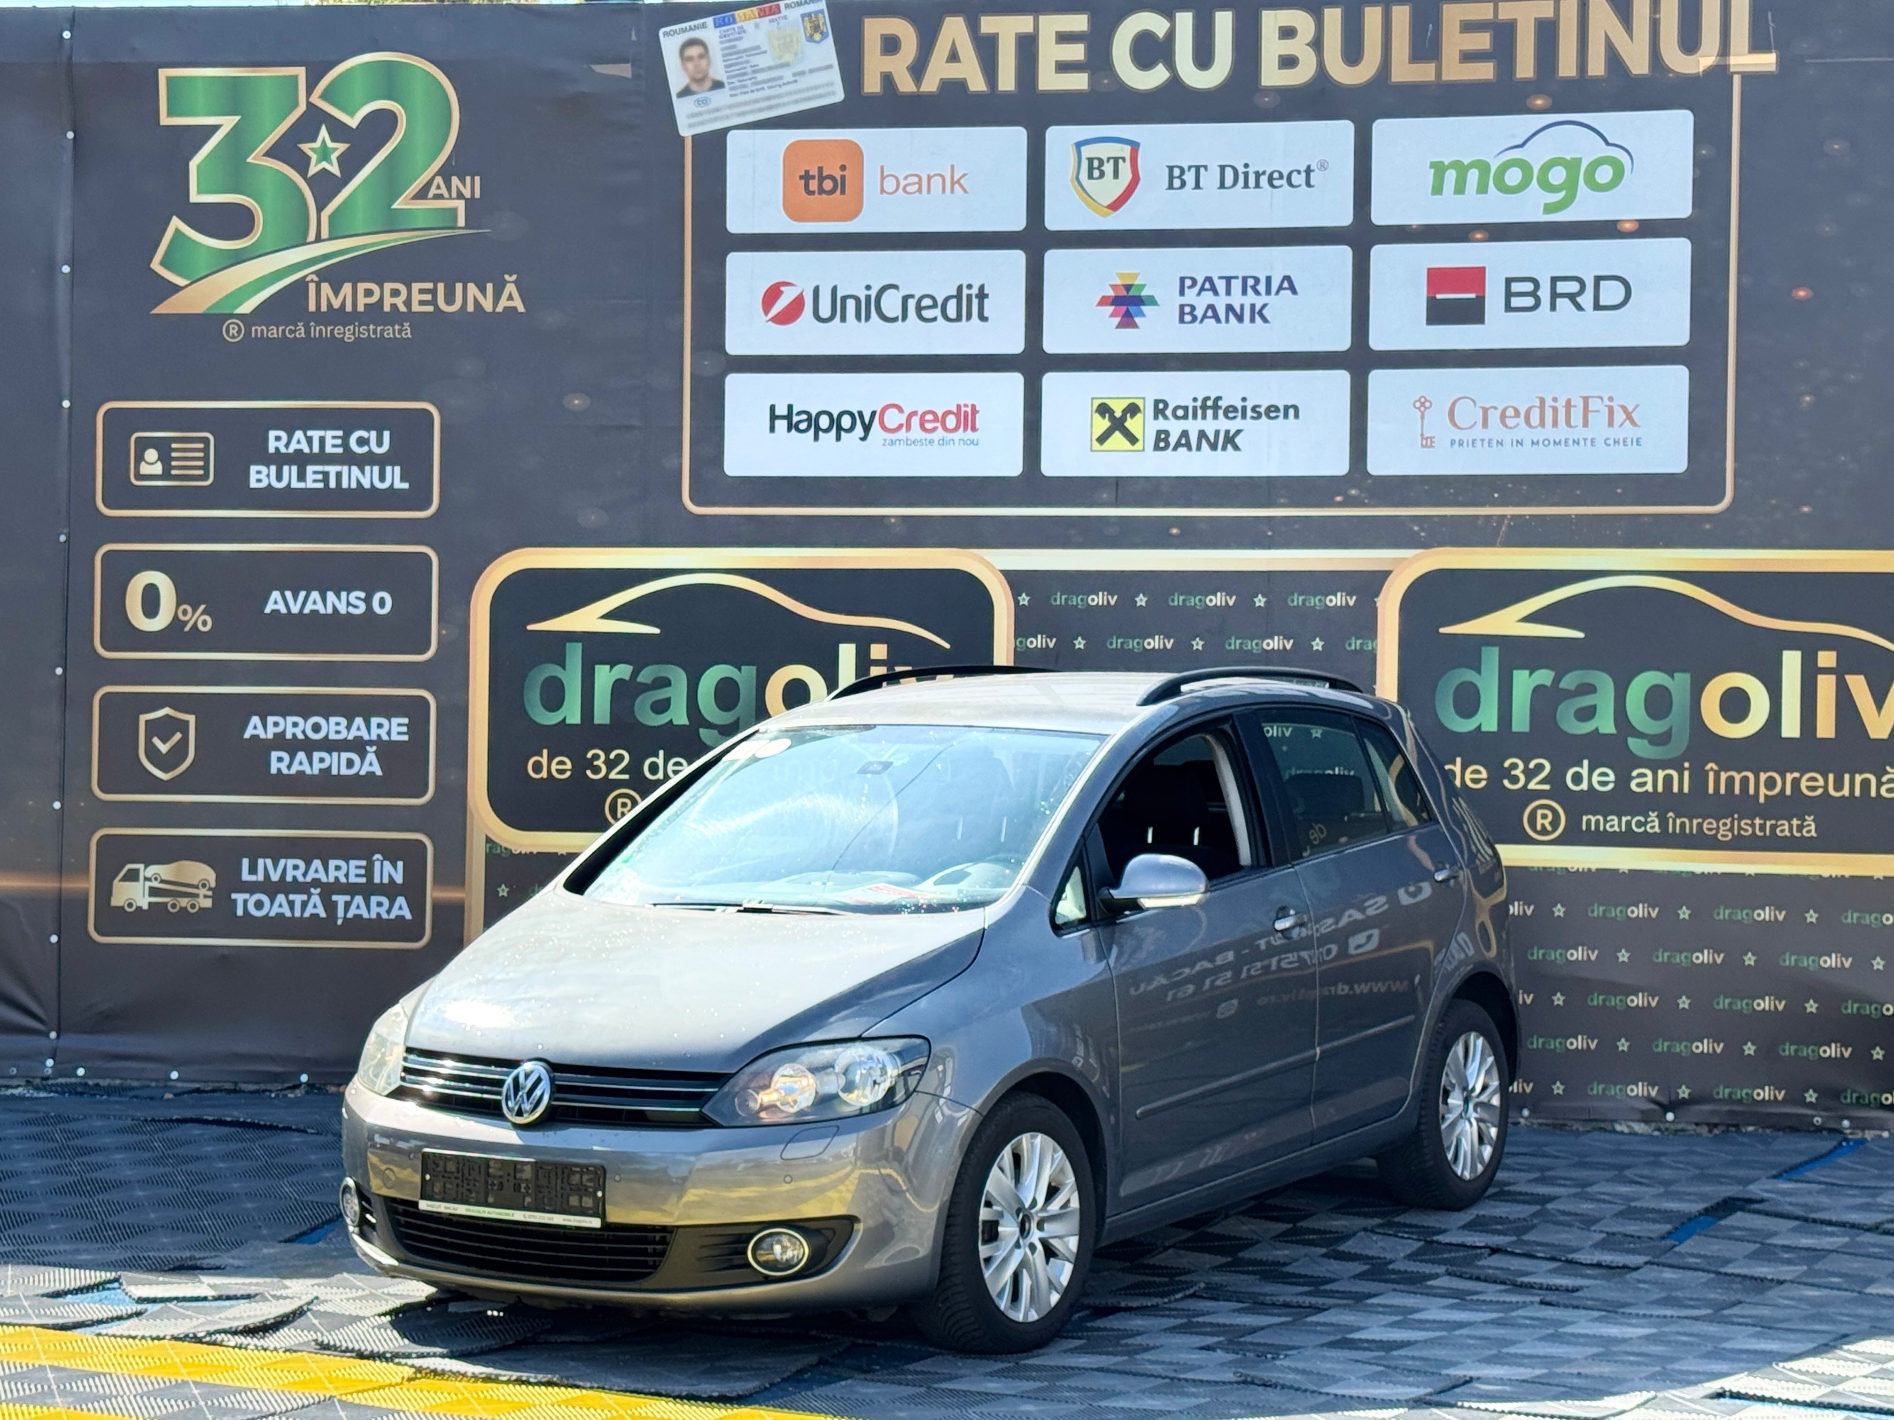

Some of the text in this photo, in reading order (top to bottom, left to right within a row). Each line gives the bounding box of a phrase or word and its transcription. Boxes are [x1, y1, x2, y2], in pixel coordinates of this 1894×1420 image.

[784, 0, 823, 11] ROMAN
[662, 21, 708, 39] ROUMANIE
[861, 13, 1090, 94] RATE
[1112, 11, 1233, 91] CU
[1260, 0, 1778, 87] BULETINUL
[150, 51, 481, 287] 32 ANI
[799, 163, 847, 196] tbi
[879, 164, 969, 196] bank
[1086, 156, 1126, 181] BT
[1165, 164, 1208, 190] BT
[1429, 153, 1626, 216] mogo
[305, 274, 526, 314] ÎMPREUNĂ
[1178, 274, 1299, 297] PATRIA
[1504, 274, 1633, 313] BRD
[812, 282, 989, 325] UniCredit
[1178, 302, 1271, 325] BANK
[251, 321, 306, 339] marcă
[309, 320, 412, 343] înregistrată
[1153, 396, 1300, 421] Raiffeisen
[1447, 394, 1642, 431] CreditFix
[769, 403, 980, 443] HappyCredit
[267, 430, 391, 454] RATE CU
[882, 436, 979, 447] zambeste din nou
[1153, 429, 1244, 453] BANK
[1450, 436, 1643, 449] PRIETEN IN MOMENTE CHEIE
[249, 465, 409, 490] BULETINUL
[264, 590, 393, 615] AVANS 0
[1050, 592, 1357, 609] dragoliv dragoliv dragoliv
[1106, 635, 1175, 652] dragoliv
[1225, 636, 1294, 653] dragoliv
[1435, 645, 1894, 760] dragoliv
[243, 716, 409, 742] APROBARE
[269, 746, 383, 776] RAPIDĂ
[528, 749, 688, 780] de 32 de
[1502, 758, 1551, 790] 32
[1565, 759, 1615, 792] de
[1630, 762, 1690, 794] ani
[1704, 762, 1894, 804] împreună
[1582, 811, 1660, 833] marcă
[1667, 812, 1817, 841] înregistrată
[241, 853, 403, 885] LIVRARE ÎN
[231, 887, 413, 926] TOATĂ ȚARA
[1588, 903, 1659, 920] dragoliv
[1713, 906, 1787, 924] dragoliv
[1527, 946, 1853, 970] dragoliv dragoliv dragoliv
[1587, 991, 1659, 1009] dragoliv
[1713, 995, 1786, 1013] dragoliv
[1527, 1034, 1852, 1060] dragoliv dragoliv dragoliv
[1587, 1081, 1659, 1099] dragoliv
[1713, 1085, 1786, 1102] dragoliv
